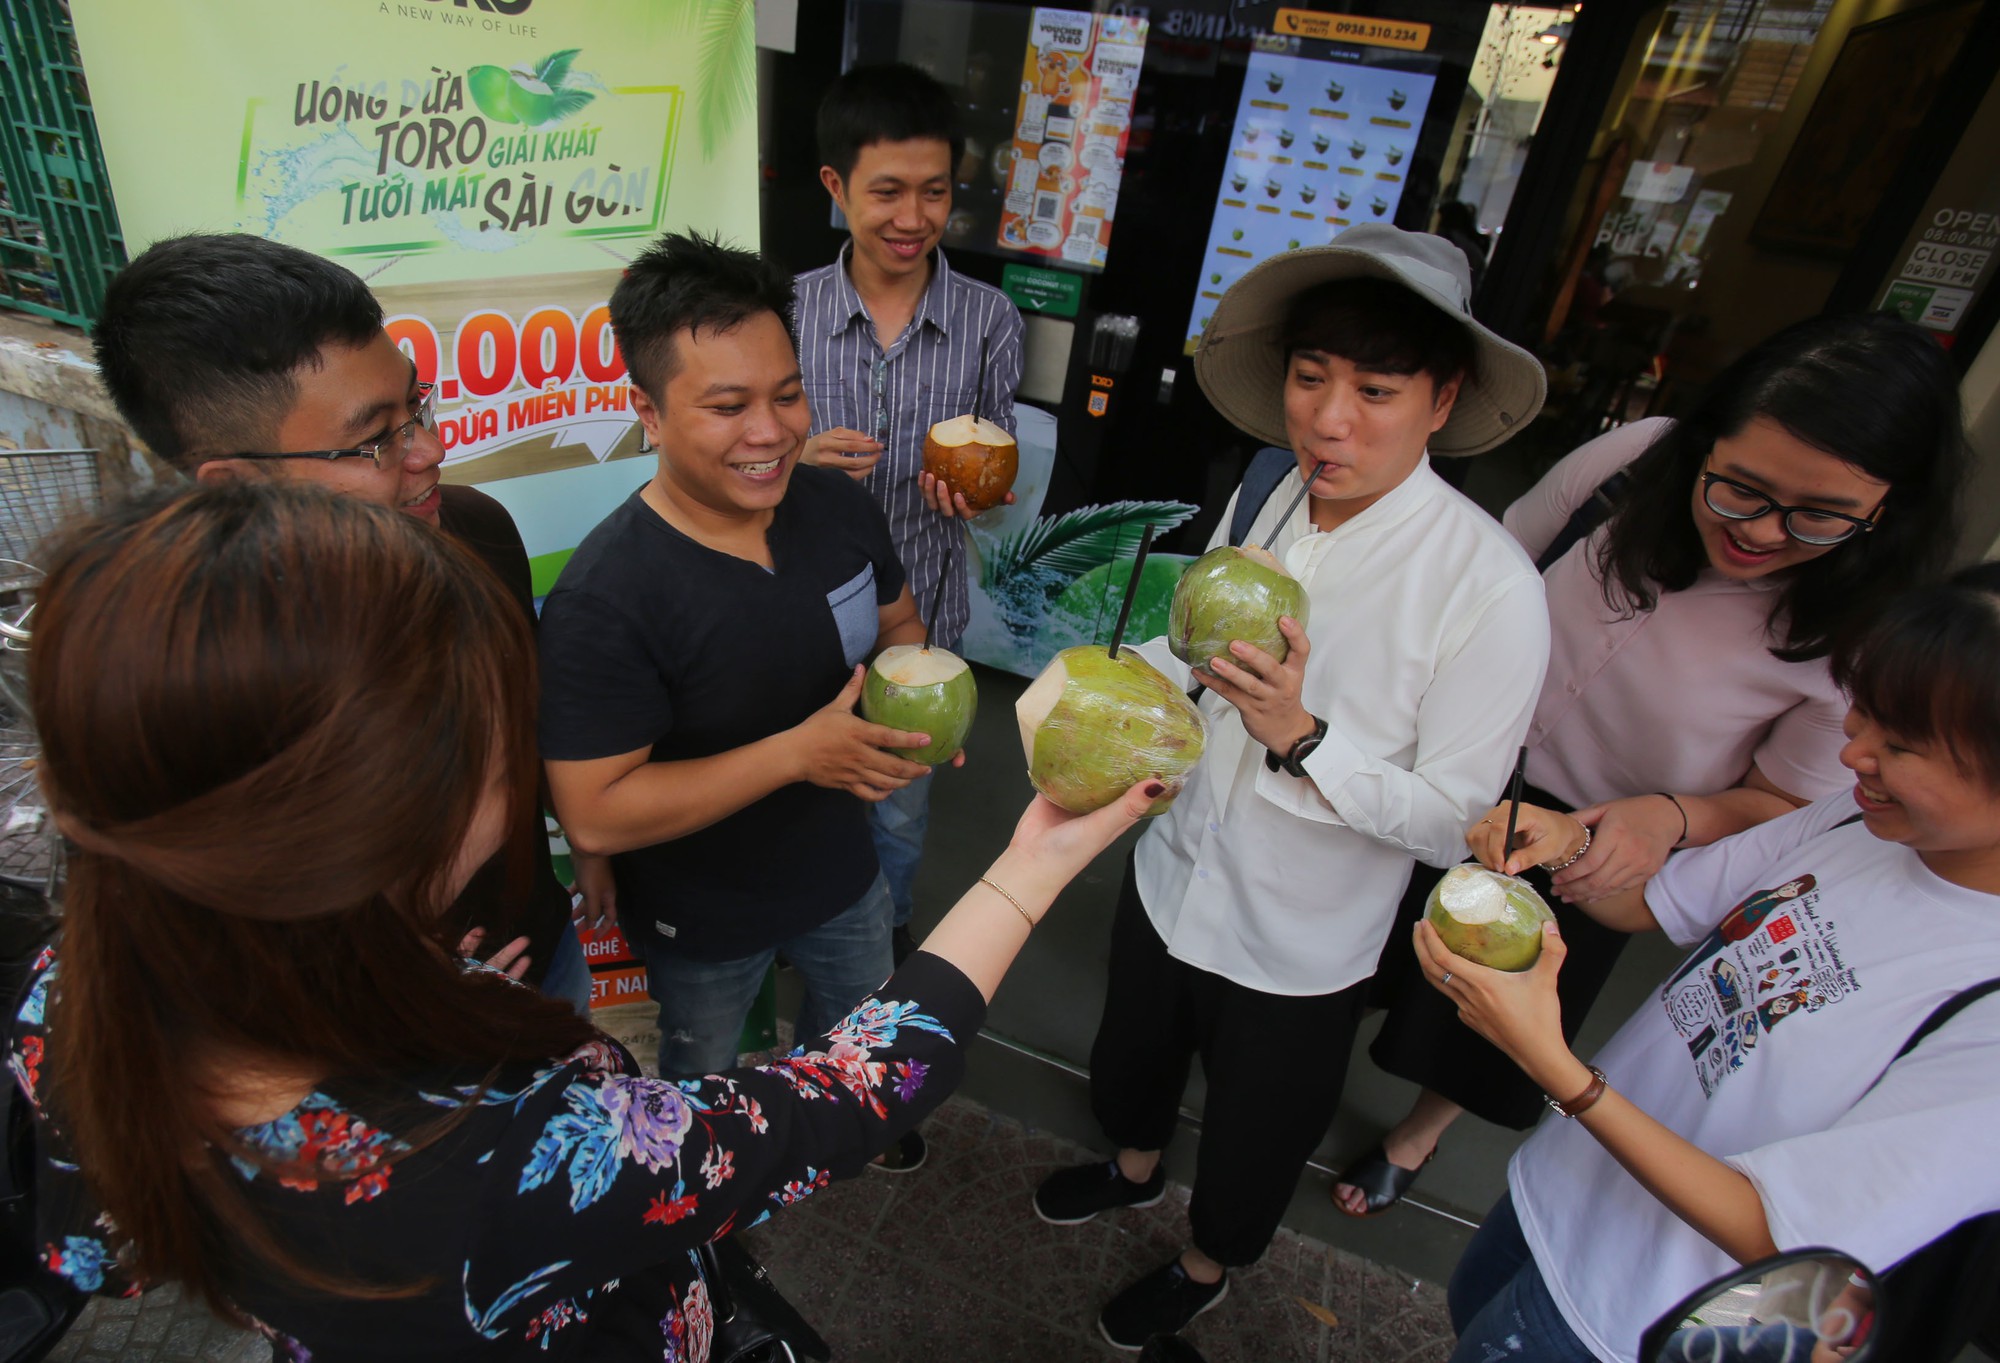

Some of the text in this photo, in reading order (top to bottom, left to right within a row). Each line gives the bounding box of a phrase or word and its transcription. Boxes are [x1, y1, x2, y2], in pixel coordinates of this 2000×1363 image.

[379, 2, 390, 14] A
[398, 5, 432, 21] NEW
[441, 12, 474, 27] WAY
[482, 19, 501, 32] OF
[509, 24, 538, 38] LIFE
[1336, 22, 1417, 42] 0938.310.234
[375, 116, 603, 176] TORO GIẢI KHÁT
[421, 167, 486, 214] MÁT
[480, 172, 553, 232] SÀI
[564, 163, 649, 224] GÒN
[1933, 208, 2000, 234] OPEN
[1924, 228, 1999, 248] 08:00 AM
[1913, 246, 1987, 270] CLOSE
[1027, 277, 1059, 288] COCONUT
[1950, 270, 1977, 284] PM
[438, 380, 629, 450] DỪA MIỄN PHÍ
[616, 975, 648, 995] NA
